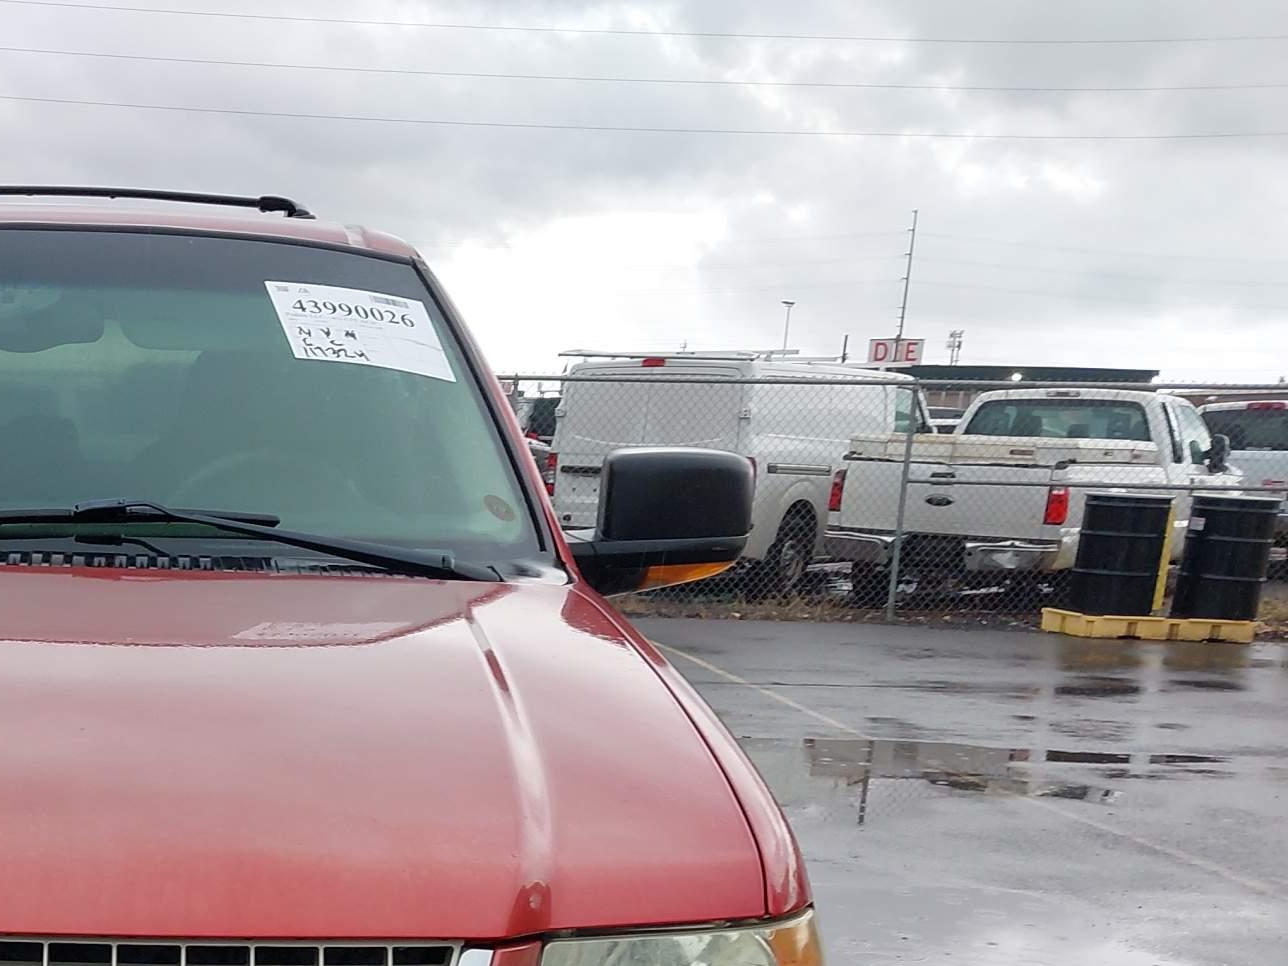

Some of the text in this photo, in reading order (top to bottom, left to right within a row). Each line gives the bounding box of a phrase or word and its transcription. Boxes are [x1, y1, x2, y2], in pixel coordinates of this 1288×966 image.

[292, 299, 415, 328] 43990026
[874, 342, 918, 361] D E
